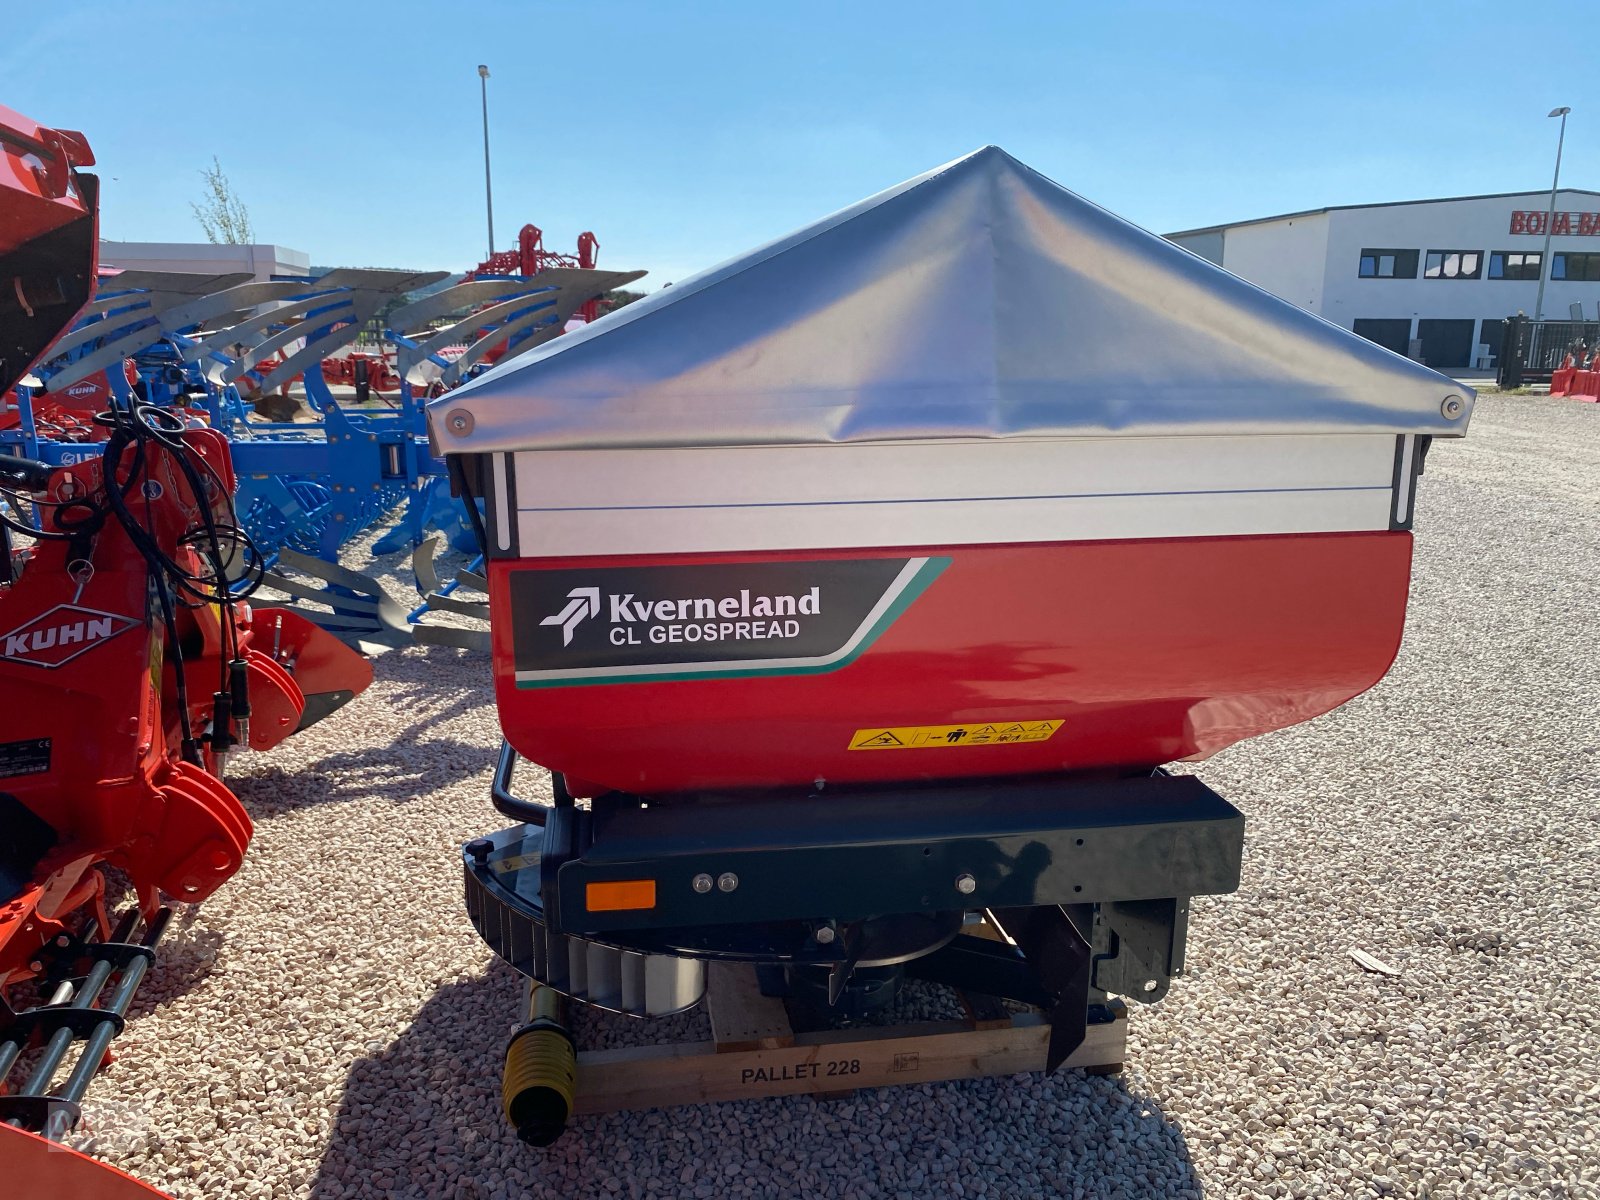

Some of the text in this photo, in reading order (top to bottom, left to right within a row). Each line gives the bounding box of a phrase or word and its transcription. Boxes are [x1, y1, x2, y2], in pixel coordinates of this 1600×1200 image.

[69, 386, 97, 395] KUHN
[608, 586, 821, 623] Kverneland
[5, 617, 112, 656] KUHN
[609, 620, 800, 645] CL GEOSPREAD
[741, 1059, 861, 1084] PALLET 228
